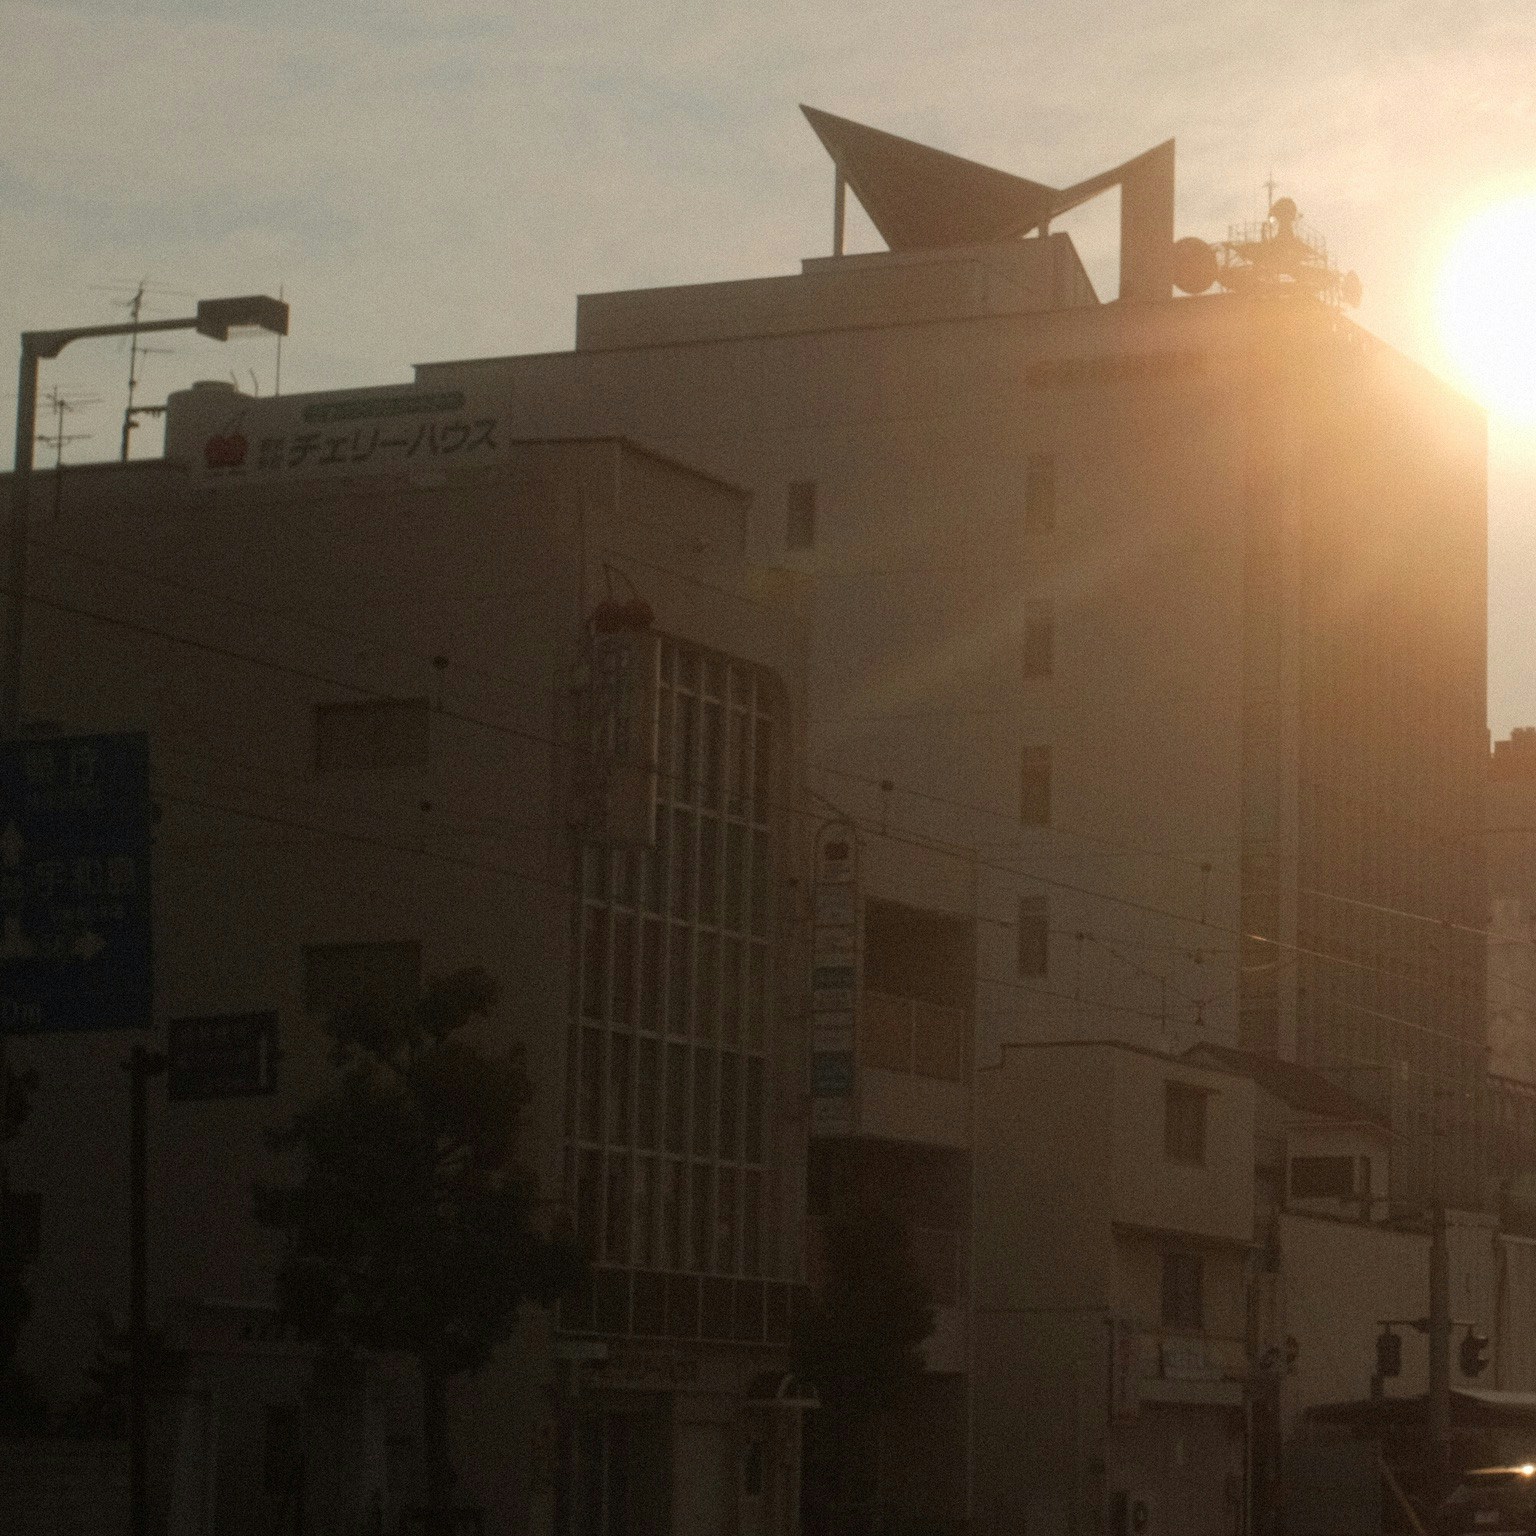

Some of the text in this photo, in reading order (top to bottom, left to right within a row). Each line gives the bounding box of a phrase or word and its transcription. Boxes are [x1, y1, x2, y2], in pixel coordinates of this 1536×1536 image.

[288, 419, 498, 467] チェリーハウス
